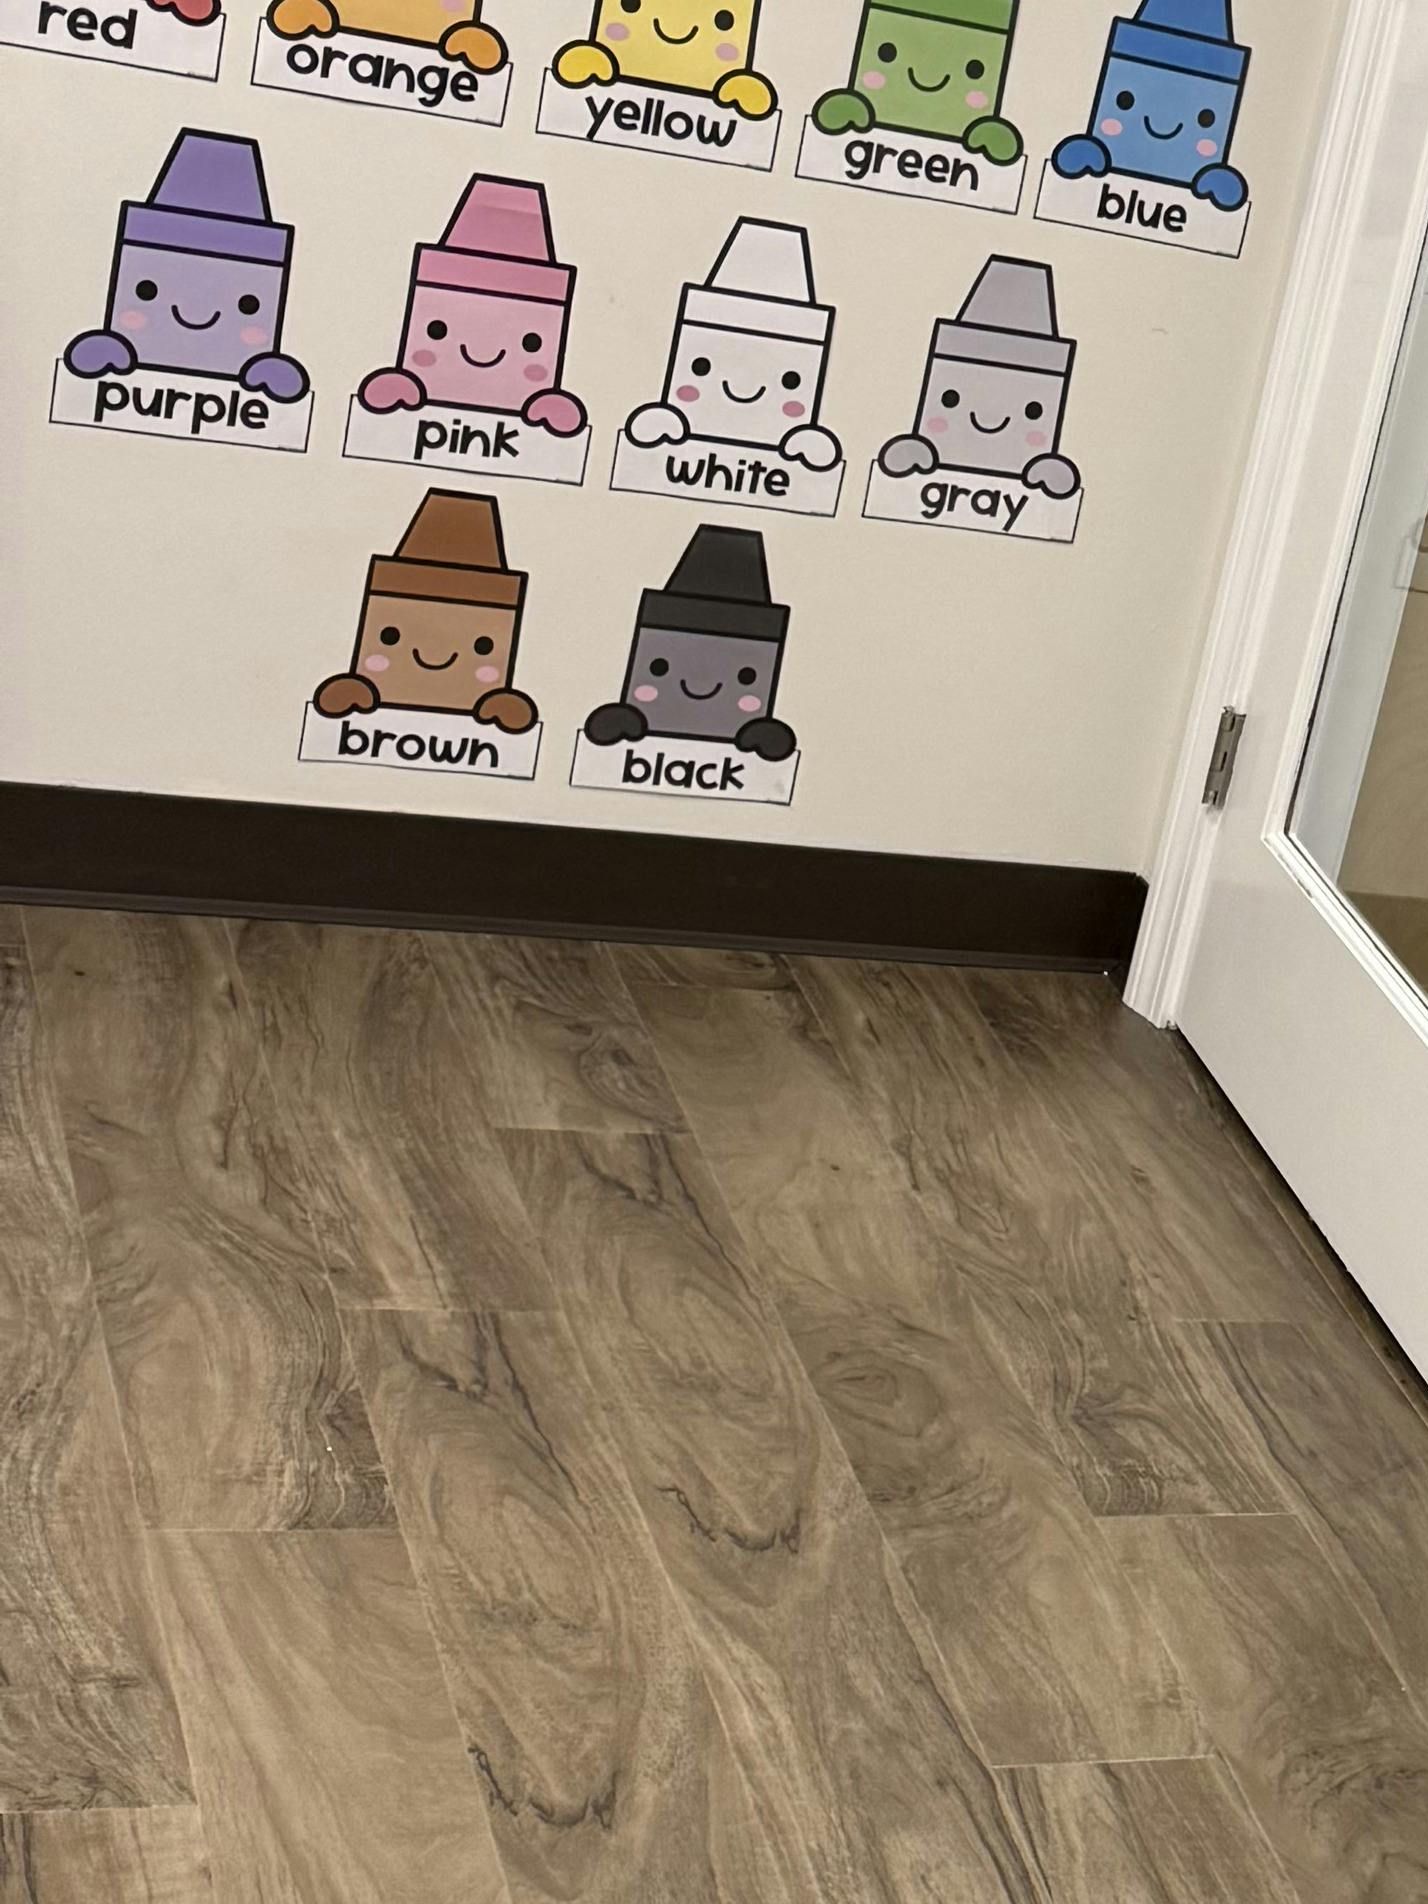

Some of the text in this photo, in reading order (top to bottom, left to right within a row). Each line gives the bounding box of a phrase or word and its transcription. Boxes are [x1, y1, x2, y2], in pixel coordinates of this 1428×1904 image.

[37, 0, 137, 50] red
[286, 42, 479, 106] orange
[585, 93, 738, 149] yellow
[846, 140, 979, 192] green
[1098, 184, 1188, 234] blue
[94, 380, 269, 433] purple
[413, 418, 520, 459] pink
[666, 456, 791, 497] white
[920, 478, 1028, 532] gray
[338, 721, 498, 769] brown
[623, 749, 745, 791] black
